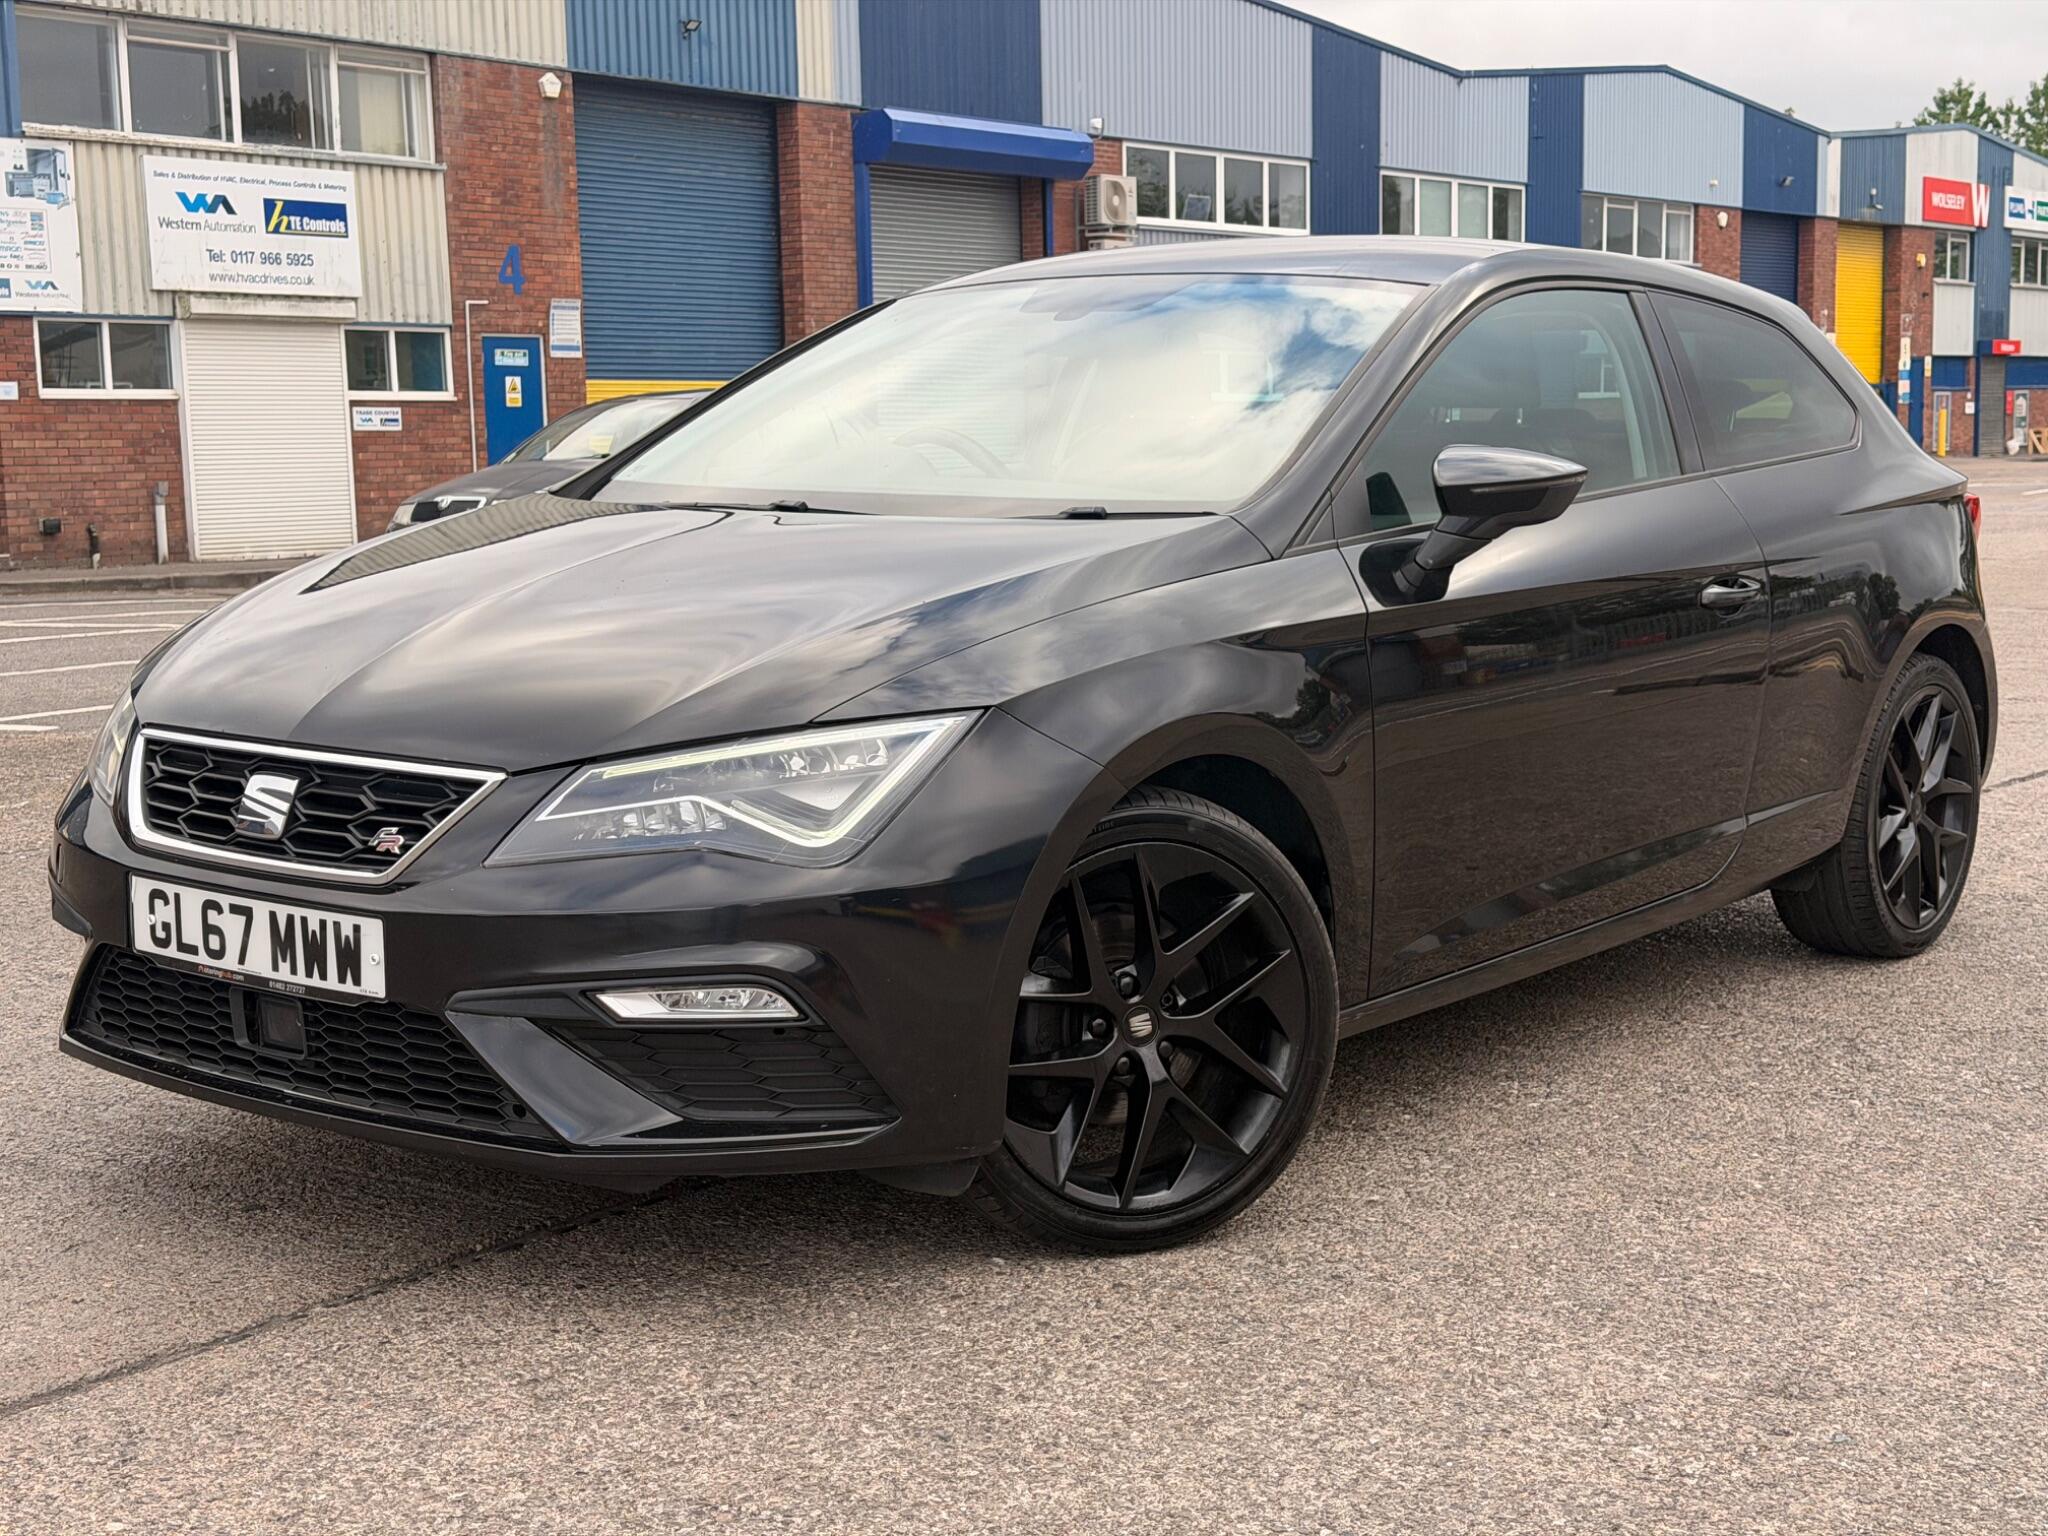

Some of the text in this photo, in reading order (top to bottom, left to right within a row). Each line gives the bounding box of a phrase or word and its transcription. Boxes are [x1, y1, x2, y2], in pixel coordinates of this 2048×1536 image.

[153, 169, 169, 178] Sales
[178, 171, 212, 181] Distribution
[269, 179, 292, 187] Process
[293, 180, 316, 189] Controls
[324, 183, 347, 192] Metering
[1931, 191, 1966, 210] WOLSELEY
[1971, 183, 1990, 228] W
[157, 216, 257, 234] Western Automation
[303, 216, 346, 233] Controls
[206, 248, 314, 267] Tel: 0117 966 5925
[208, 272, 315, 286] www.hvacdrives.co.uk
[498, 244, 526, 295] 4
[368, 826, 405, 855] FR
[148, 887, 362, 987] GL67 MWW
